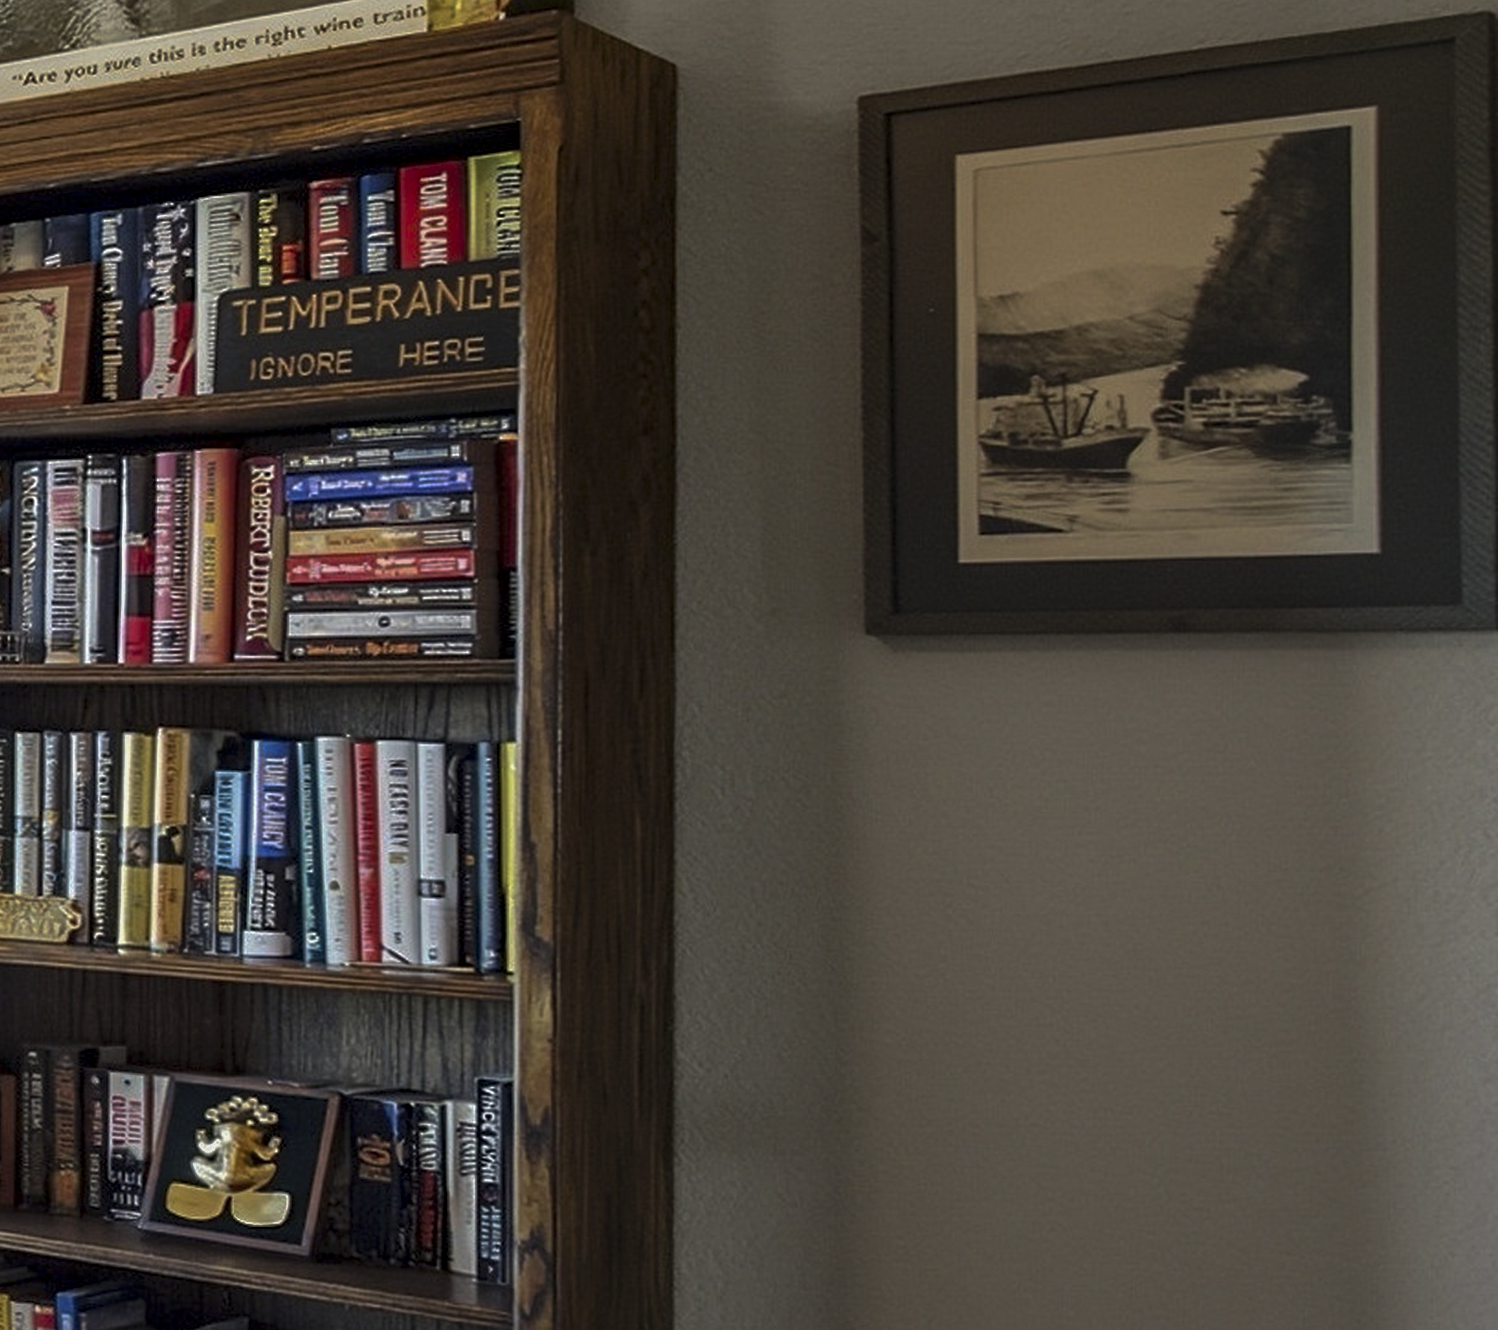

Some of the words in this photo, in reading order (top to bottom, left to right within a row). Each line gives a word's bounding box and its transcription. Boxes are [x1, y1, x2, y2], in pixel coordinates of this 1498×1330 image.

[64, 64, 98, 83] you
[105, 56, 141, 73] sure
[148, 46, 184, 65] this
[191, 43, 206, 58] is
[213, 36, 247, 53] the
[254, 25, 305, 47] right
[312, 16, 364, 36] wine
[372, 4, 426, 25] train
[258, 193, 278, 222] The
[420, 173, 447, 210] TOM
[102, 213, 123, 246] Tom
[319, 192, 349, 233] Tom
[102, 300, 123, 335] Debt
[232, 268, 521, 336] TEMPERANCE
[249, 350, 354, 381] IGNORE
[399, 336, 486, 368] HERE
[248, 464, 276, 548] ROBERT
[264, 757, 288, 787] TOM
[388, 759, 409, 779] NO
[388, 783, 410, 817] EASY
[261, 791, 287, 850] CLANCY
[389, 822, 410, 848] DAY
[481, 1085, 500, 1136] VINCE
